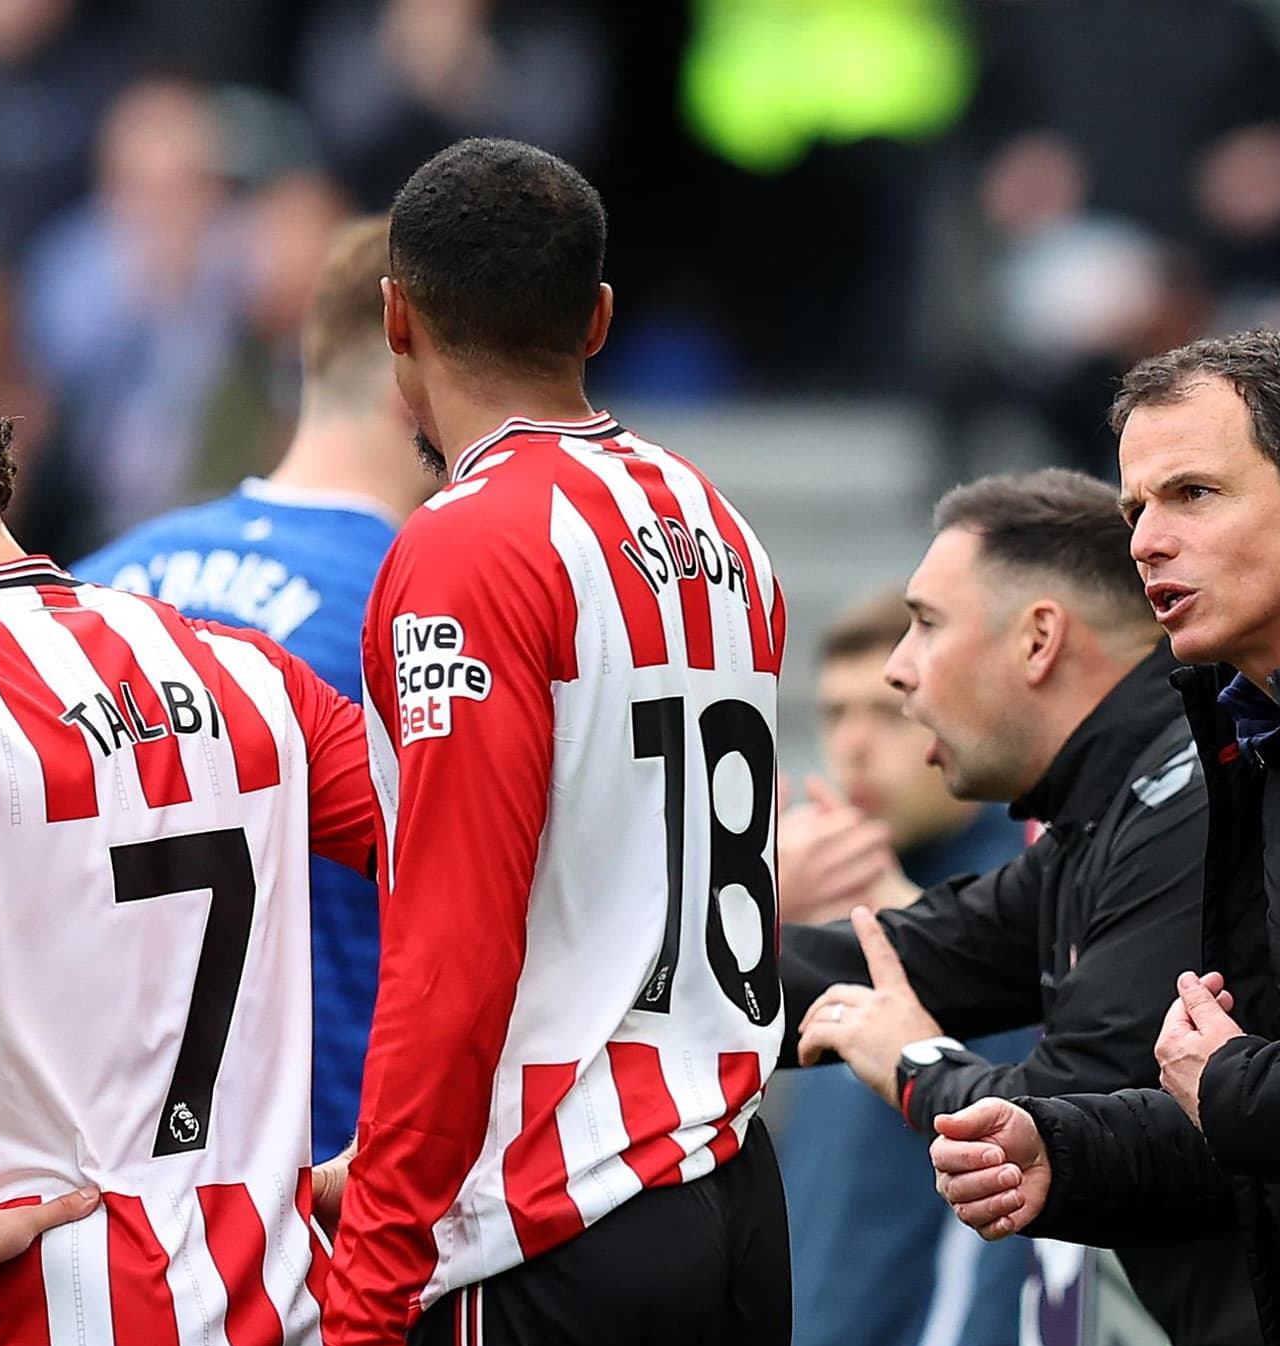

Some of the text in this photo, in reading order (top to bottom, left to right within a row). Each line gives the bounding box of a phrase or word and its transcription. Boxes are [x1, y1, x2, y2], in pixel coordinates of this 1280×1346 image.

[622, 519, 749, 606] ISIDOR
[395, 619, 457, 658] Live
[62, 681, 220, 758] TALBI
[399, 662, 486, 699] Score
[631, 696, 781, 1028] 18
[109, 826, 256, 1158] 7
